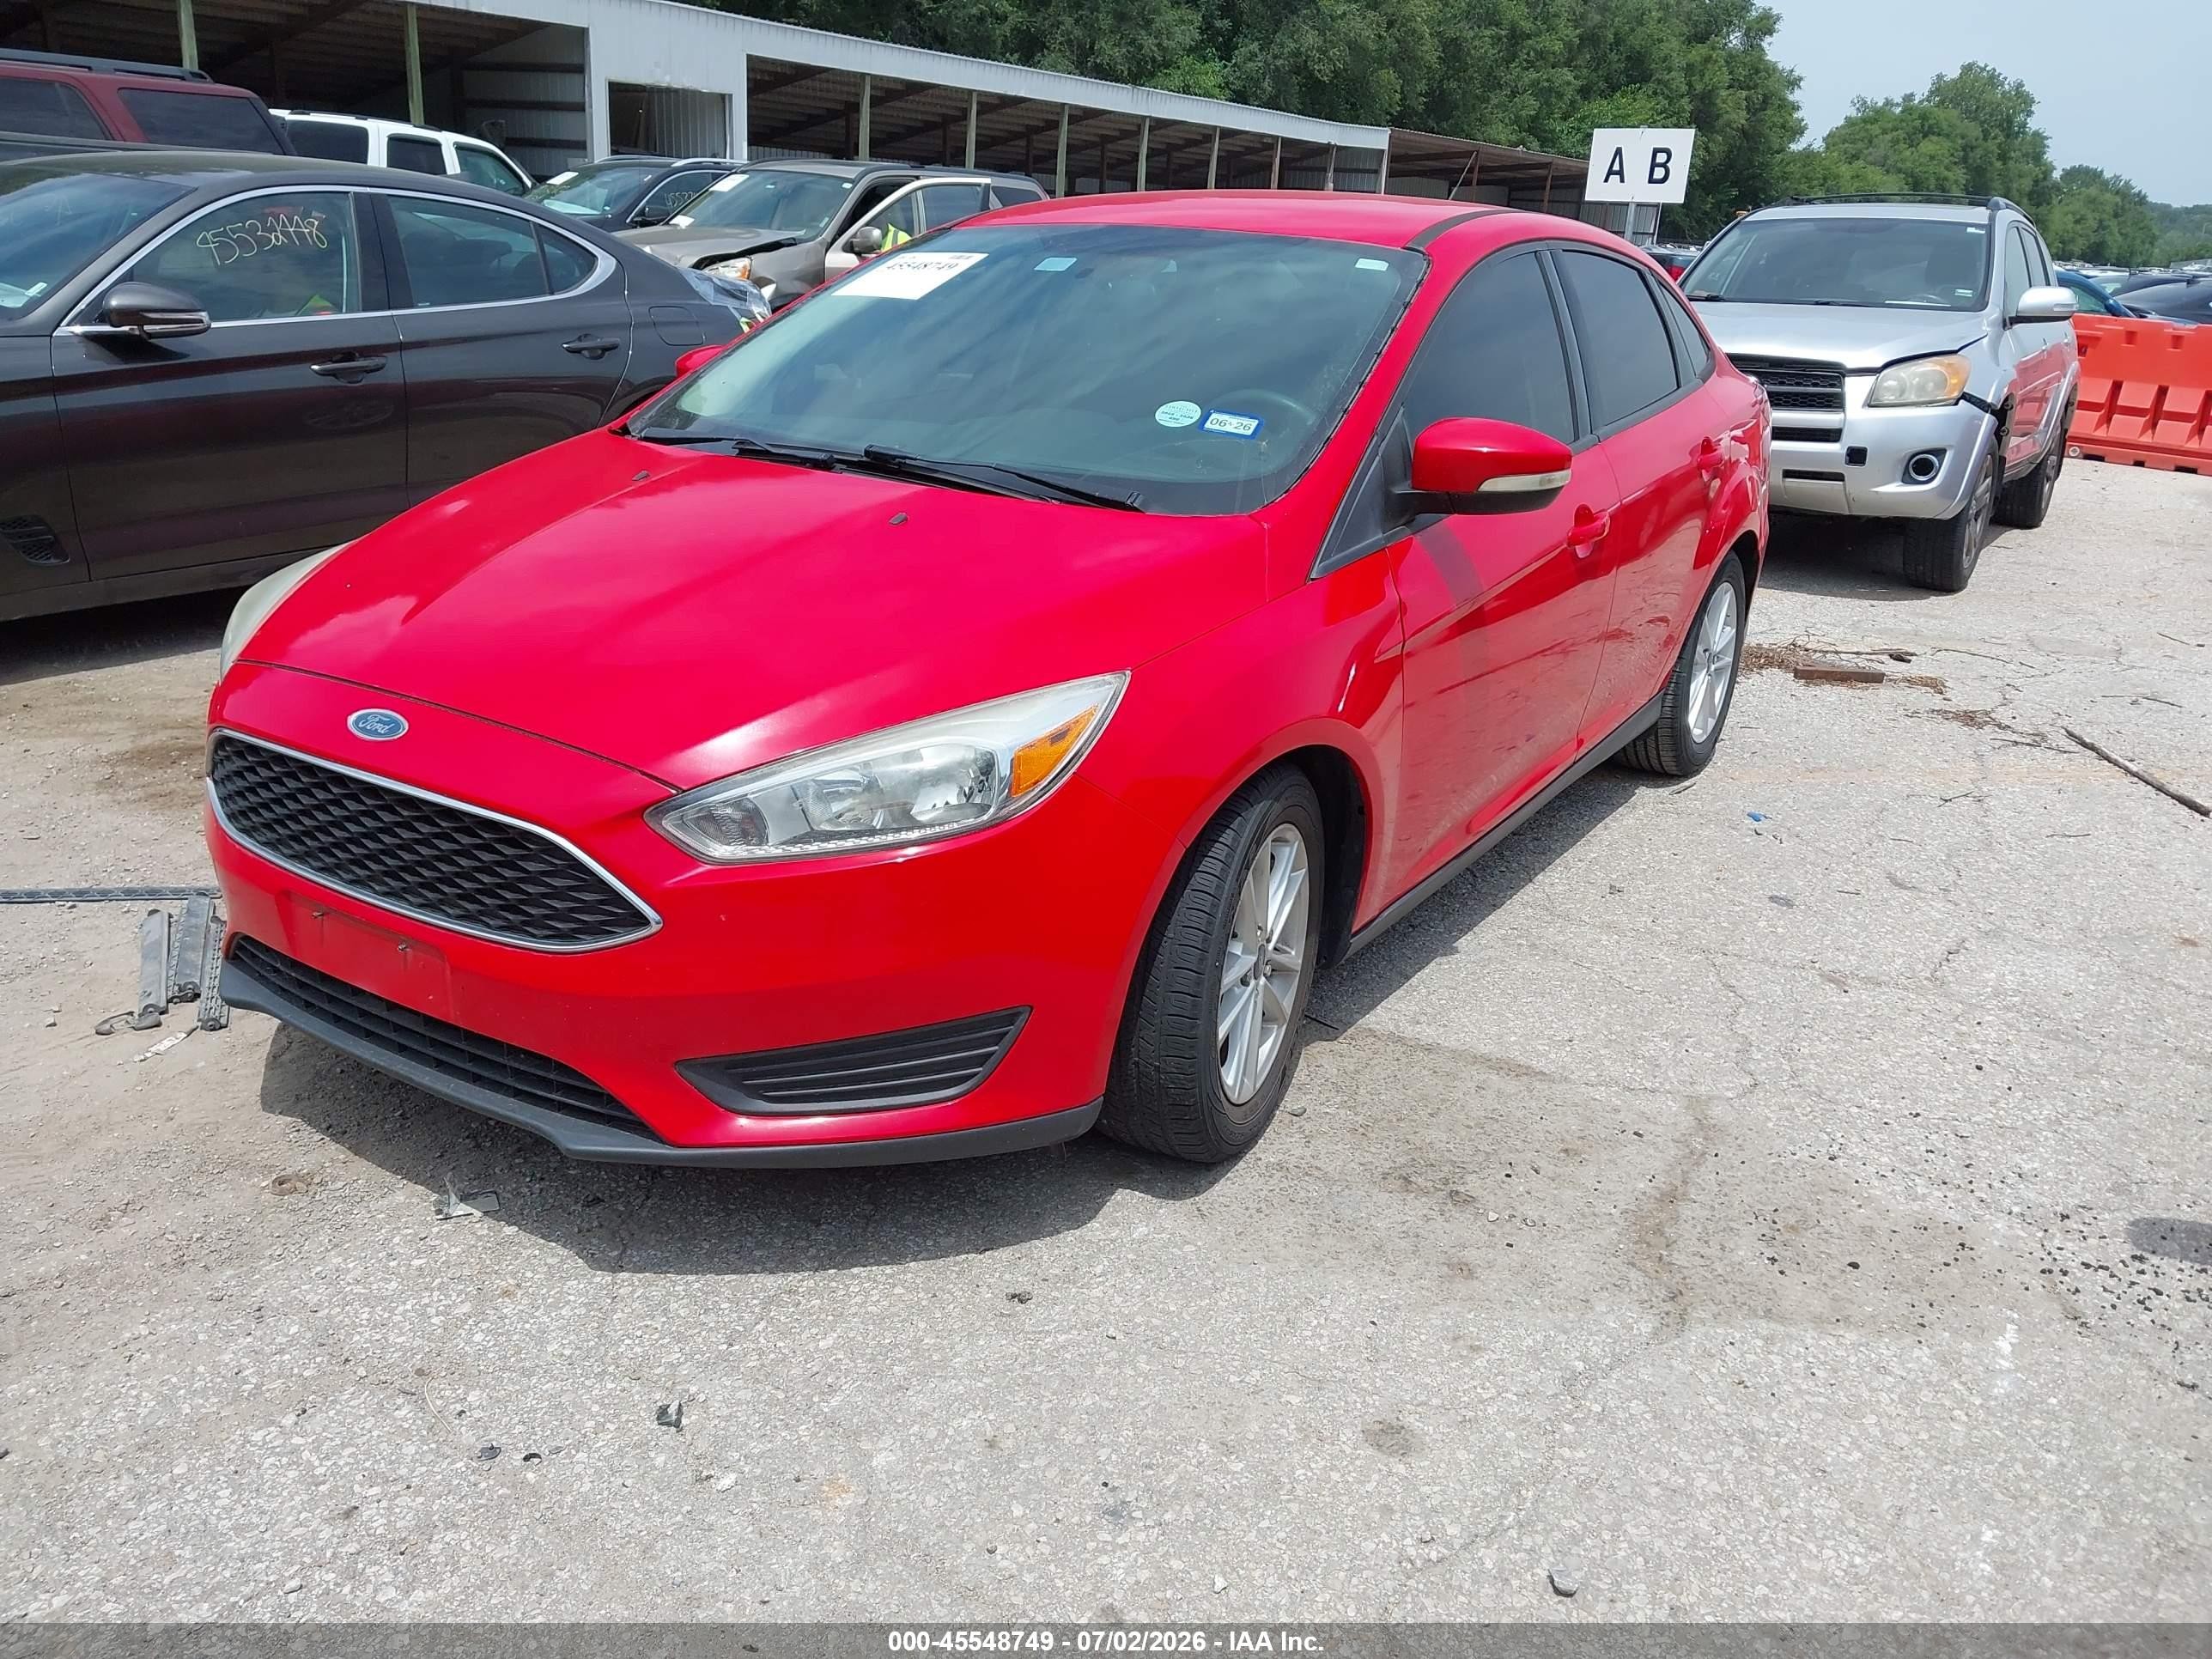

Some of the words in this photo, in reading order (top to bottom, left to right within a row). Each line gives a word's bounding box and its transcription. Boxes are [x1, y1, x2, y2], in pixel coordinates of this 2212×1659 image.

[1603, 147, 1625, 183] A
[1648, 147, 1672, 184] B
[1209, 417, 1229, 428] 06
[1233, 422, 1253, 431] 26
[359, 714, 395, 733] Ford
